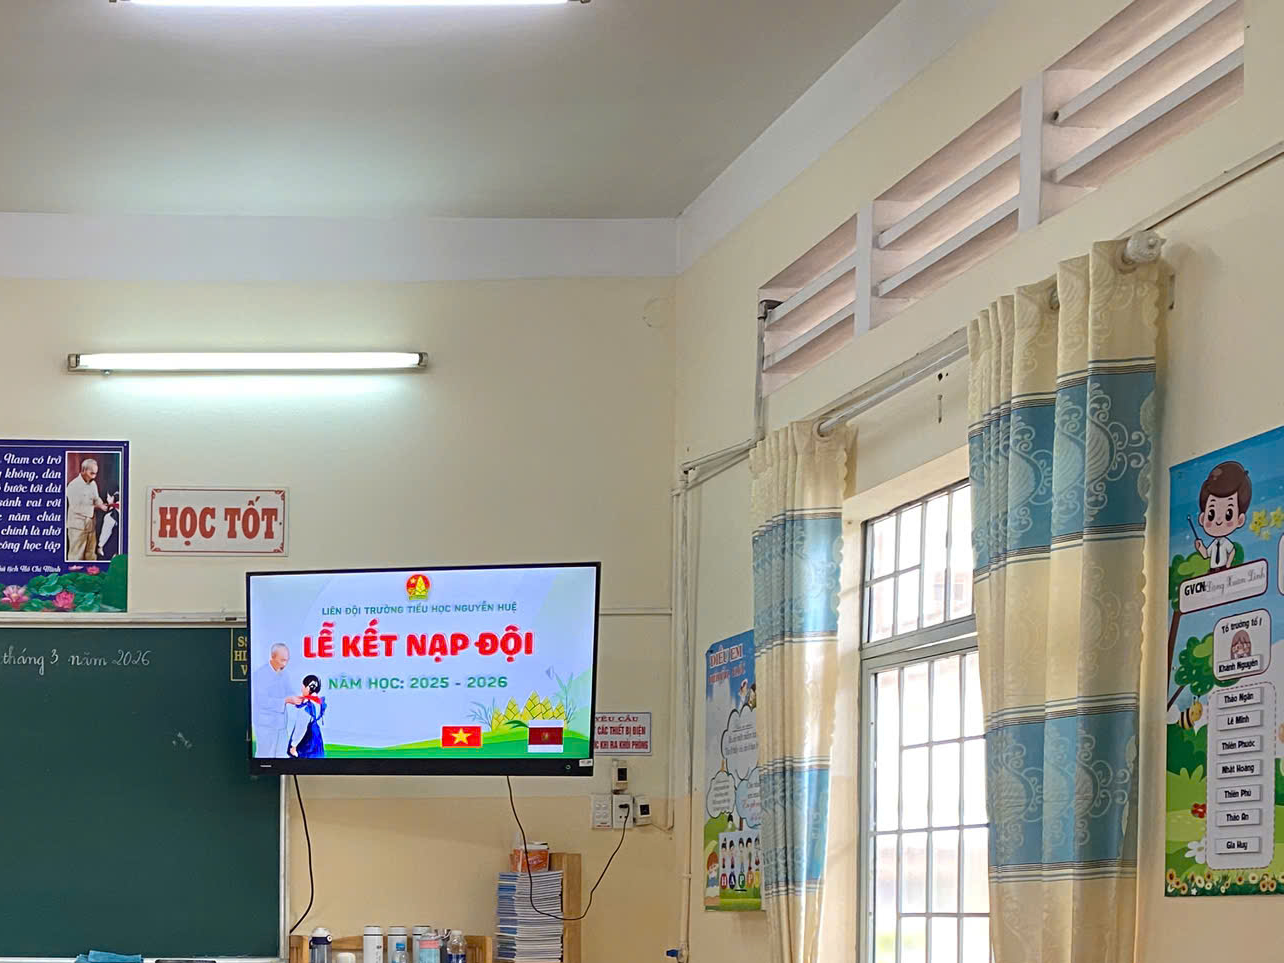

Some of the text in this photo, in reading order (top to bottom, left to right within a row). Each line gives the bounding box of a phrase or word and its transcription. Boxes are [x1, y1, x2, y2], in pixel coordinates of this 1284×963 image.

[158, 496, 278, 546] HỌC TỐT
[322, 601, 517, 615] LIÊN ĐỘI TRƯỜNG TIỂU HỌC NGUYỄN HUỆ
[303, 618, 533, 663] LỄ KẾT NẠP ĐỘI
[0, 646, 44, 675] tháng
[51, 651, 58, 665] 3
[68, 651, 107, 666] năm
[113, 650, 151, 666] 2026
[328, 675, 361, 689] NĂM
[368, 678, 404, 692] HỌC:
[410, 677, 449, 689] 2025
[467, 676, 508, 688] 2026
